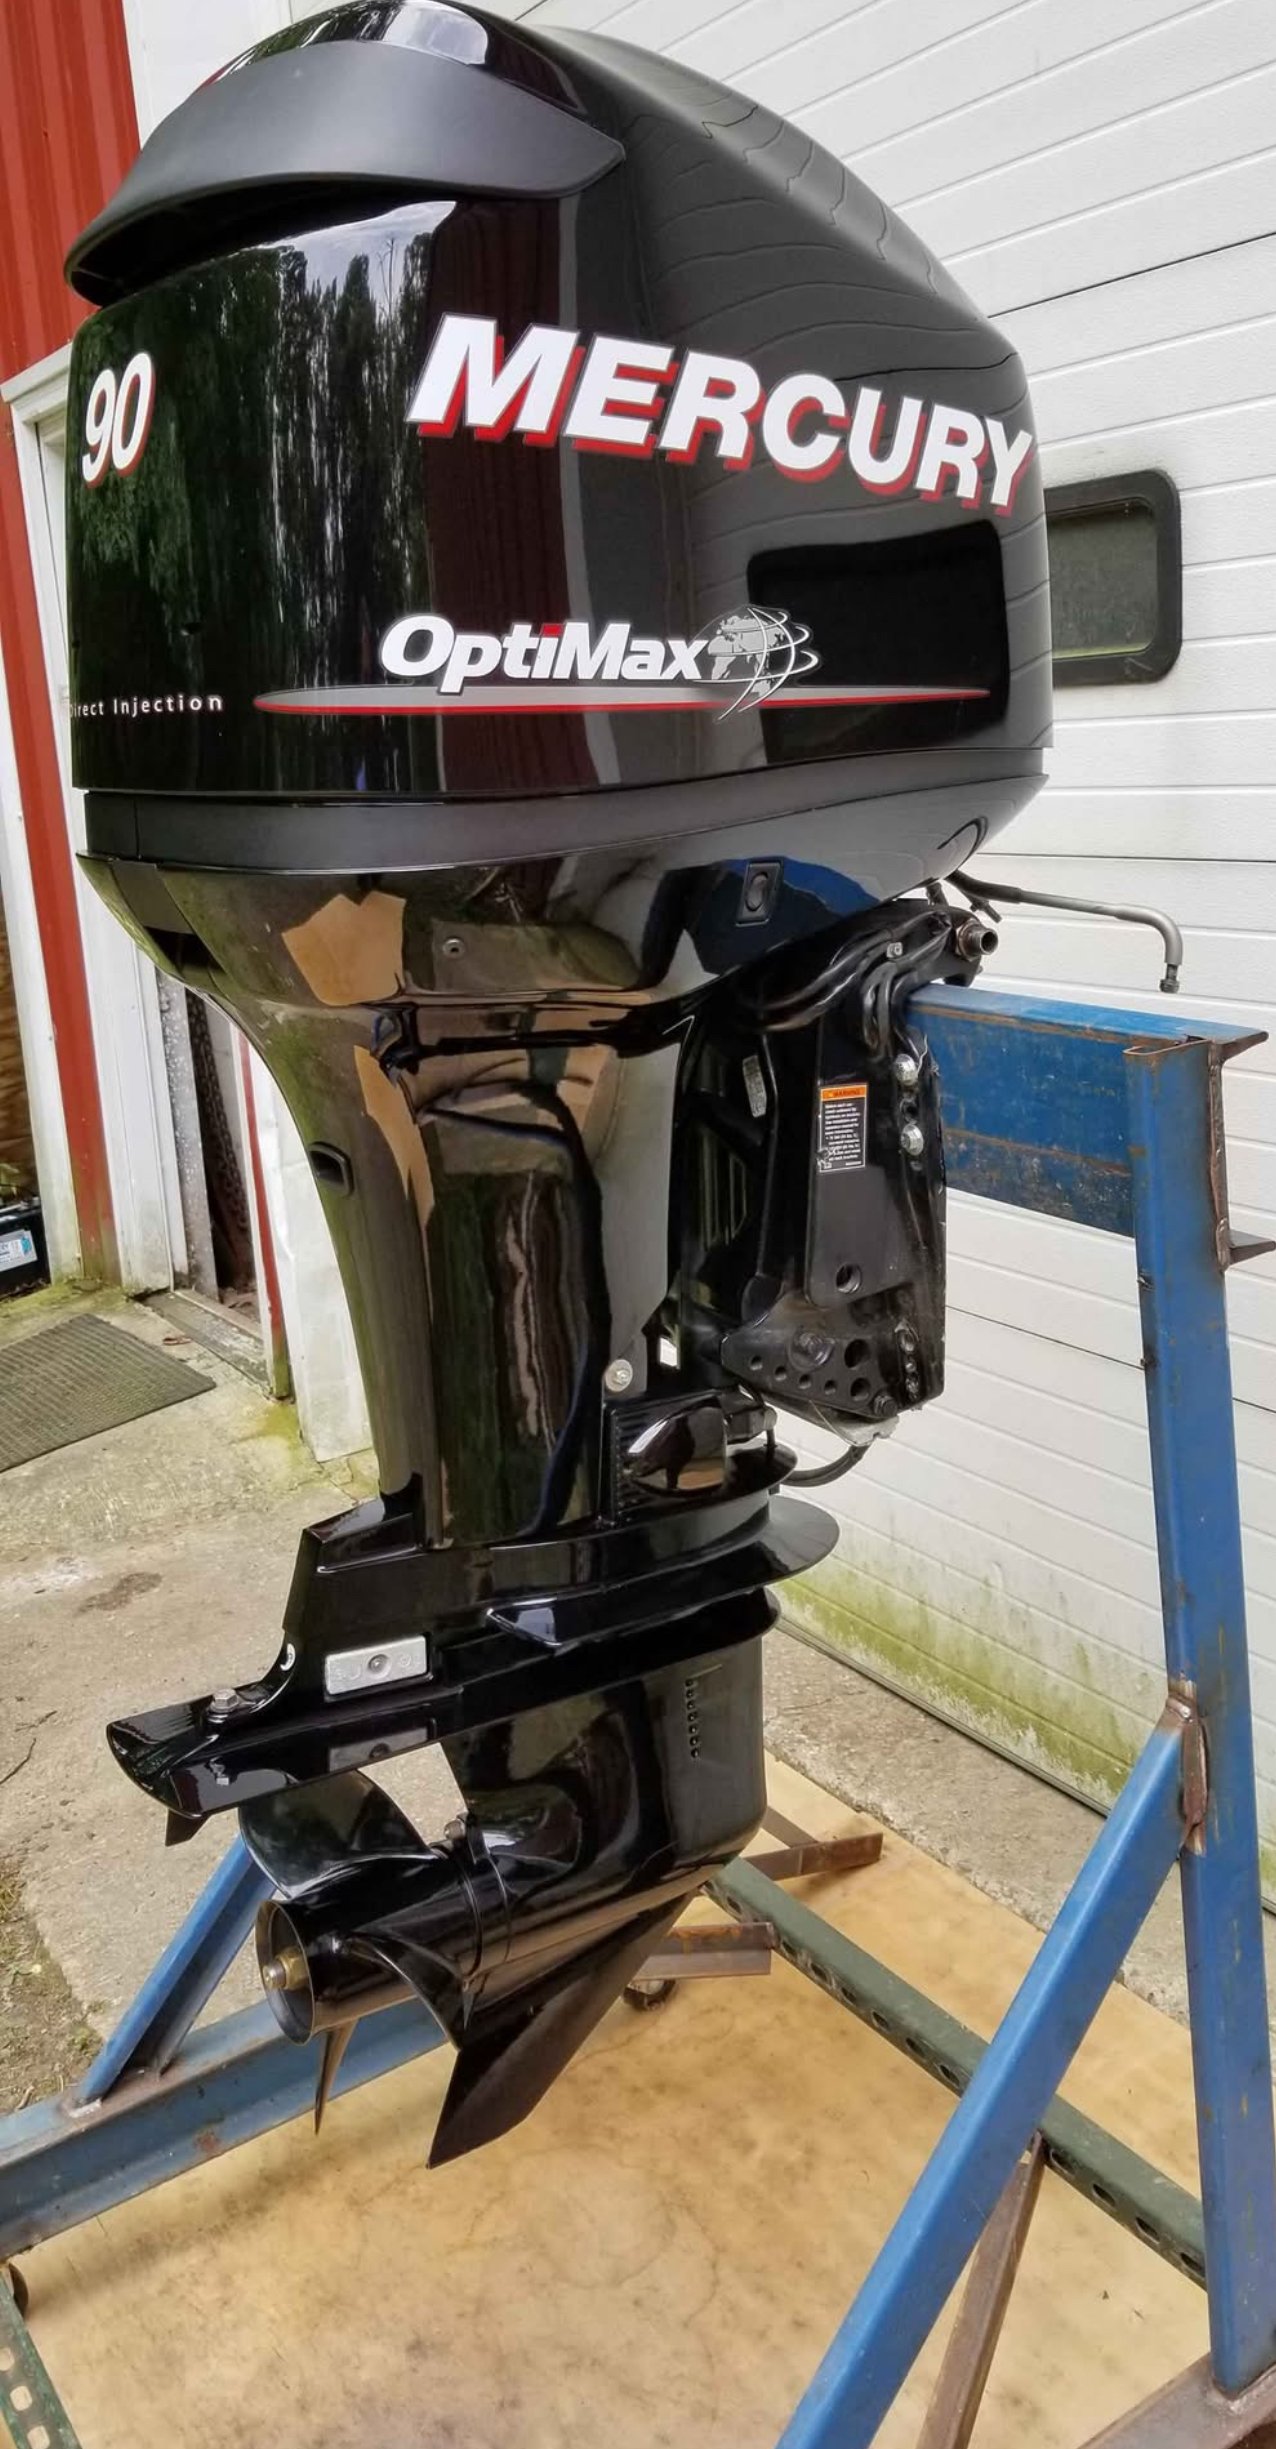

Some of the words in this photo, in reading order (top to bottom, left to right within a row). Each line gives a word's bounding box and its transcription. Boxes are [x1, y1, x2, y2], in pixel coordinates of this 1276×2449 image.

[82, 353, 155, 488] 90
[407, 313, 1033, 515] MERCURY
[113, 694, 223, 718] Injection
[381, 615, 708, 693] OptiMax
